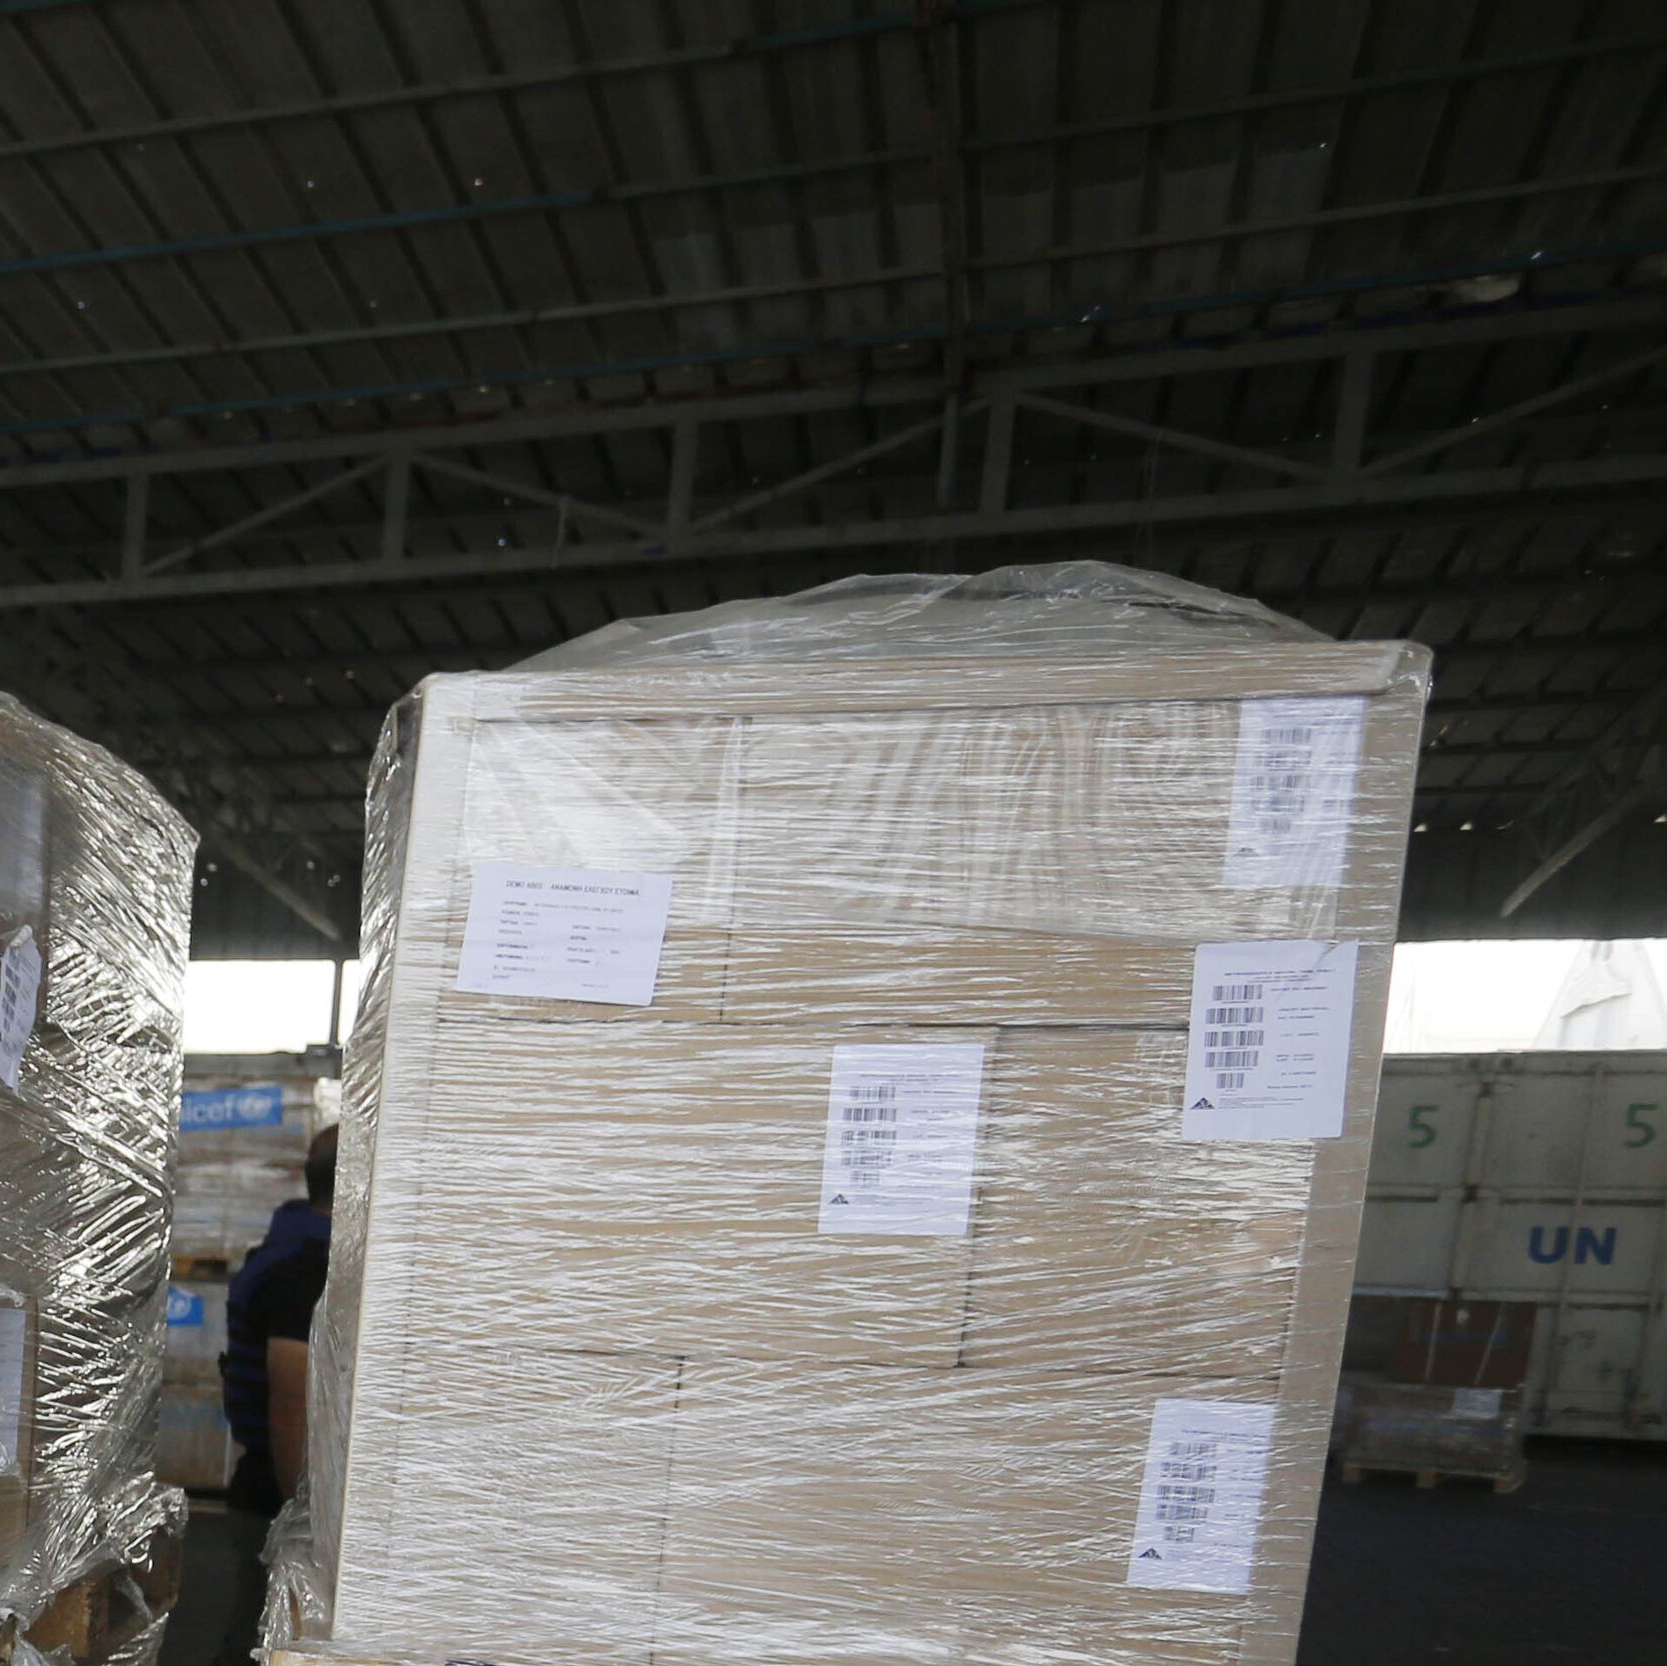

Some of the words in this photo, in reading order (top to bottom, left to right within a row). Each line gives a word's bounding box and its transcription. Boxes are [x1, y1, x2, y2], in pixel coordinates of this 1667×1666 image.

[1407, 1104, 1439, 1149] 5
[1623, 1103, 1657, 1149] 5
[1527, 1225, 1617, 1266] UN
